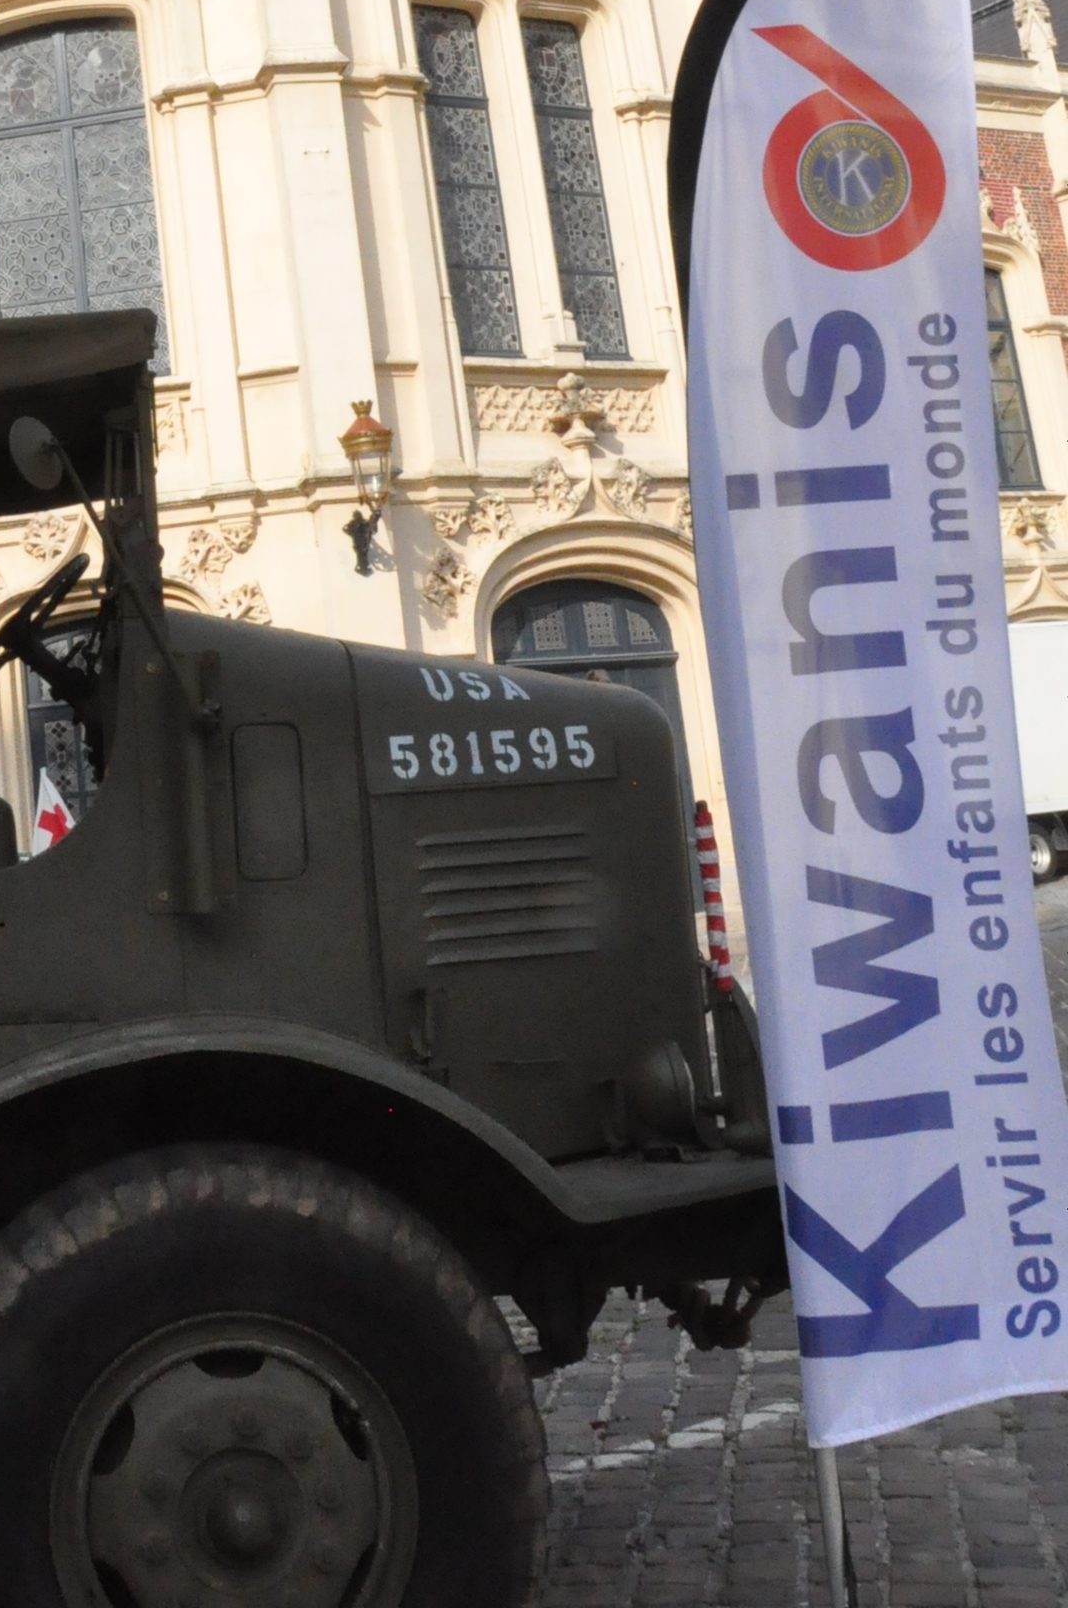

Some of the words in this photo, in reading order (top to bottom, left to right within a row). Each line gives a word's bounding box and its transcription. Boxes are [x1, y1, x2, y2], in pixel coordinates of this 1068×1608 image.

[835, 149, 876, 207] K
[906, 312, 969, 542] monde
[925, 574, 978, 655] du
[420, 667, 530, 702] USA
[388, 724, 596, 780] 581595
[725, 308, 980, 1359] Kiwanis
[937, 686, 1009, 951] enfants
[974, 982, 1029, 1086] les
[985, 1116, 1061, 1339] Servir
